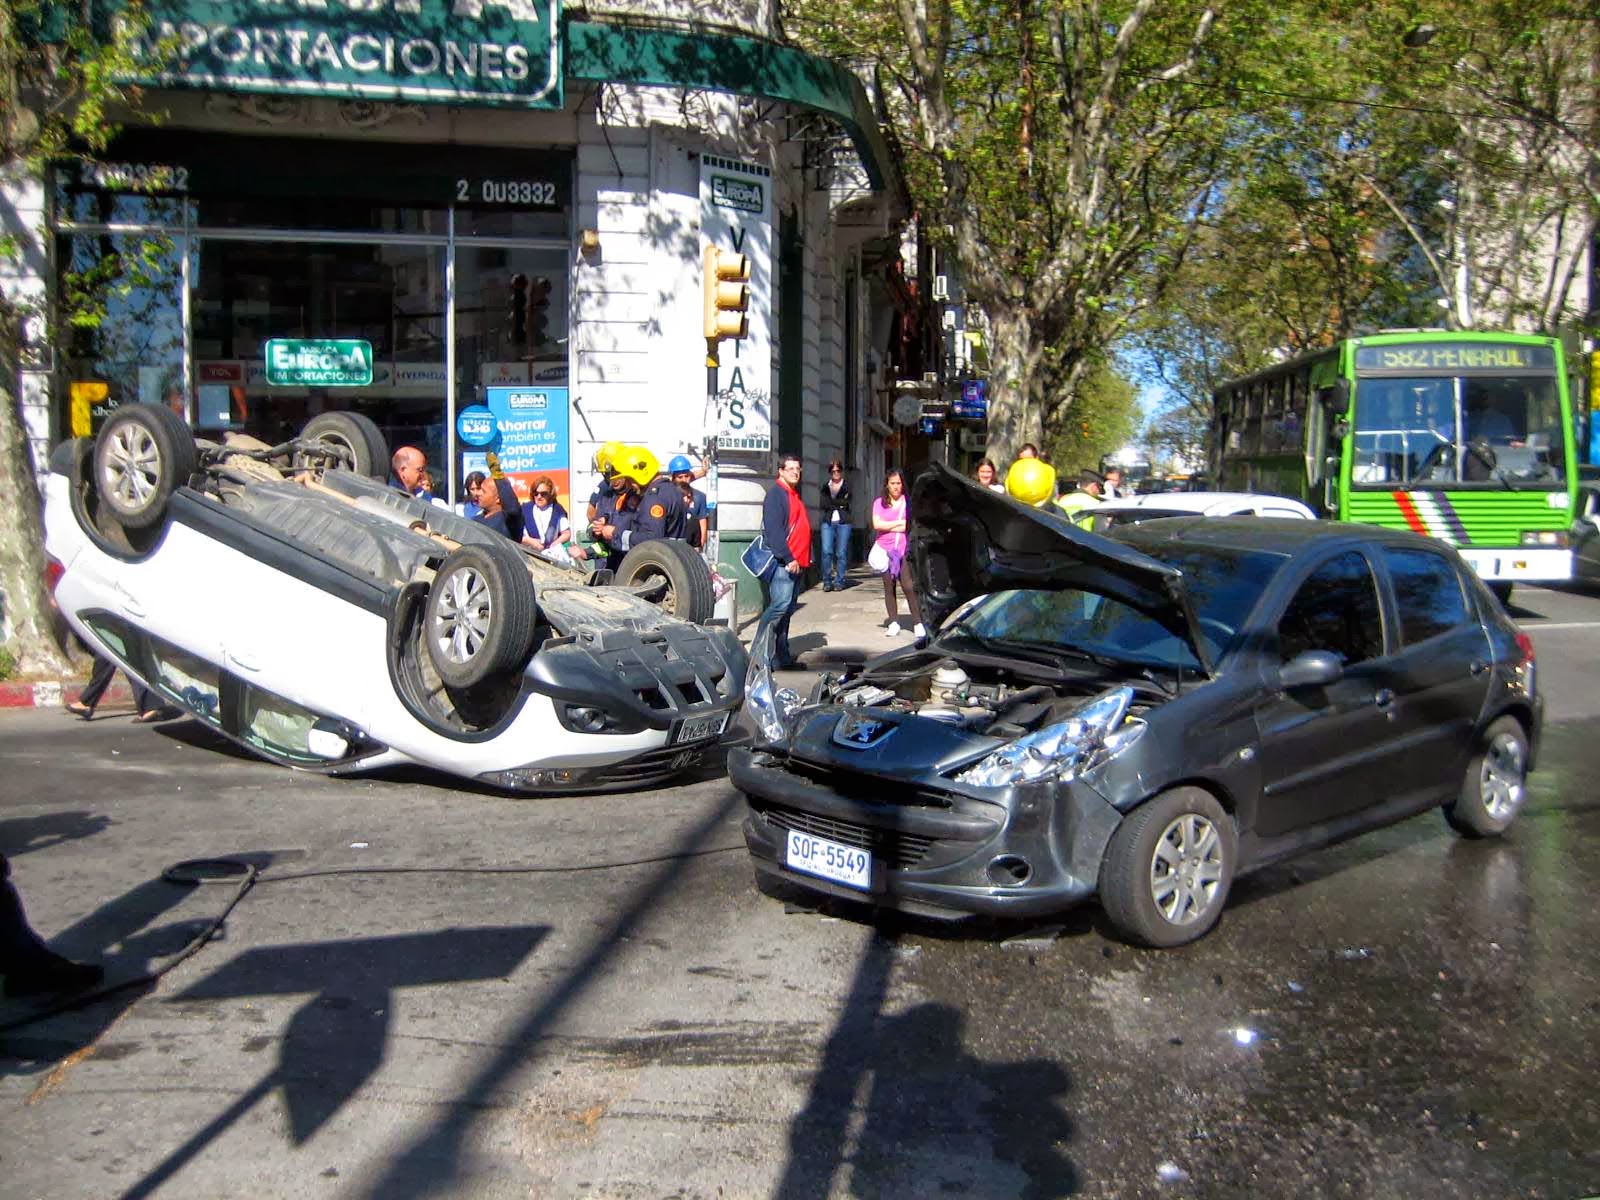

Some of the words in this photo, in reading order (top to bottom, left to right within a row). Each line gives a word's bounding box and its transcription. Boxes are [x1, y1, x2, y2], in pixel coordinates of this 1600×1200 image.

[1384, 350, 1429, 367] 582
[274, 371, 366, 380] IMPORTACIONES
[497, 419, 546, 432] Ahorrar
[501, 432, 541, 443] ambién
[498, 443, 557, 457] Comprar
